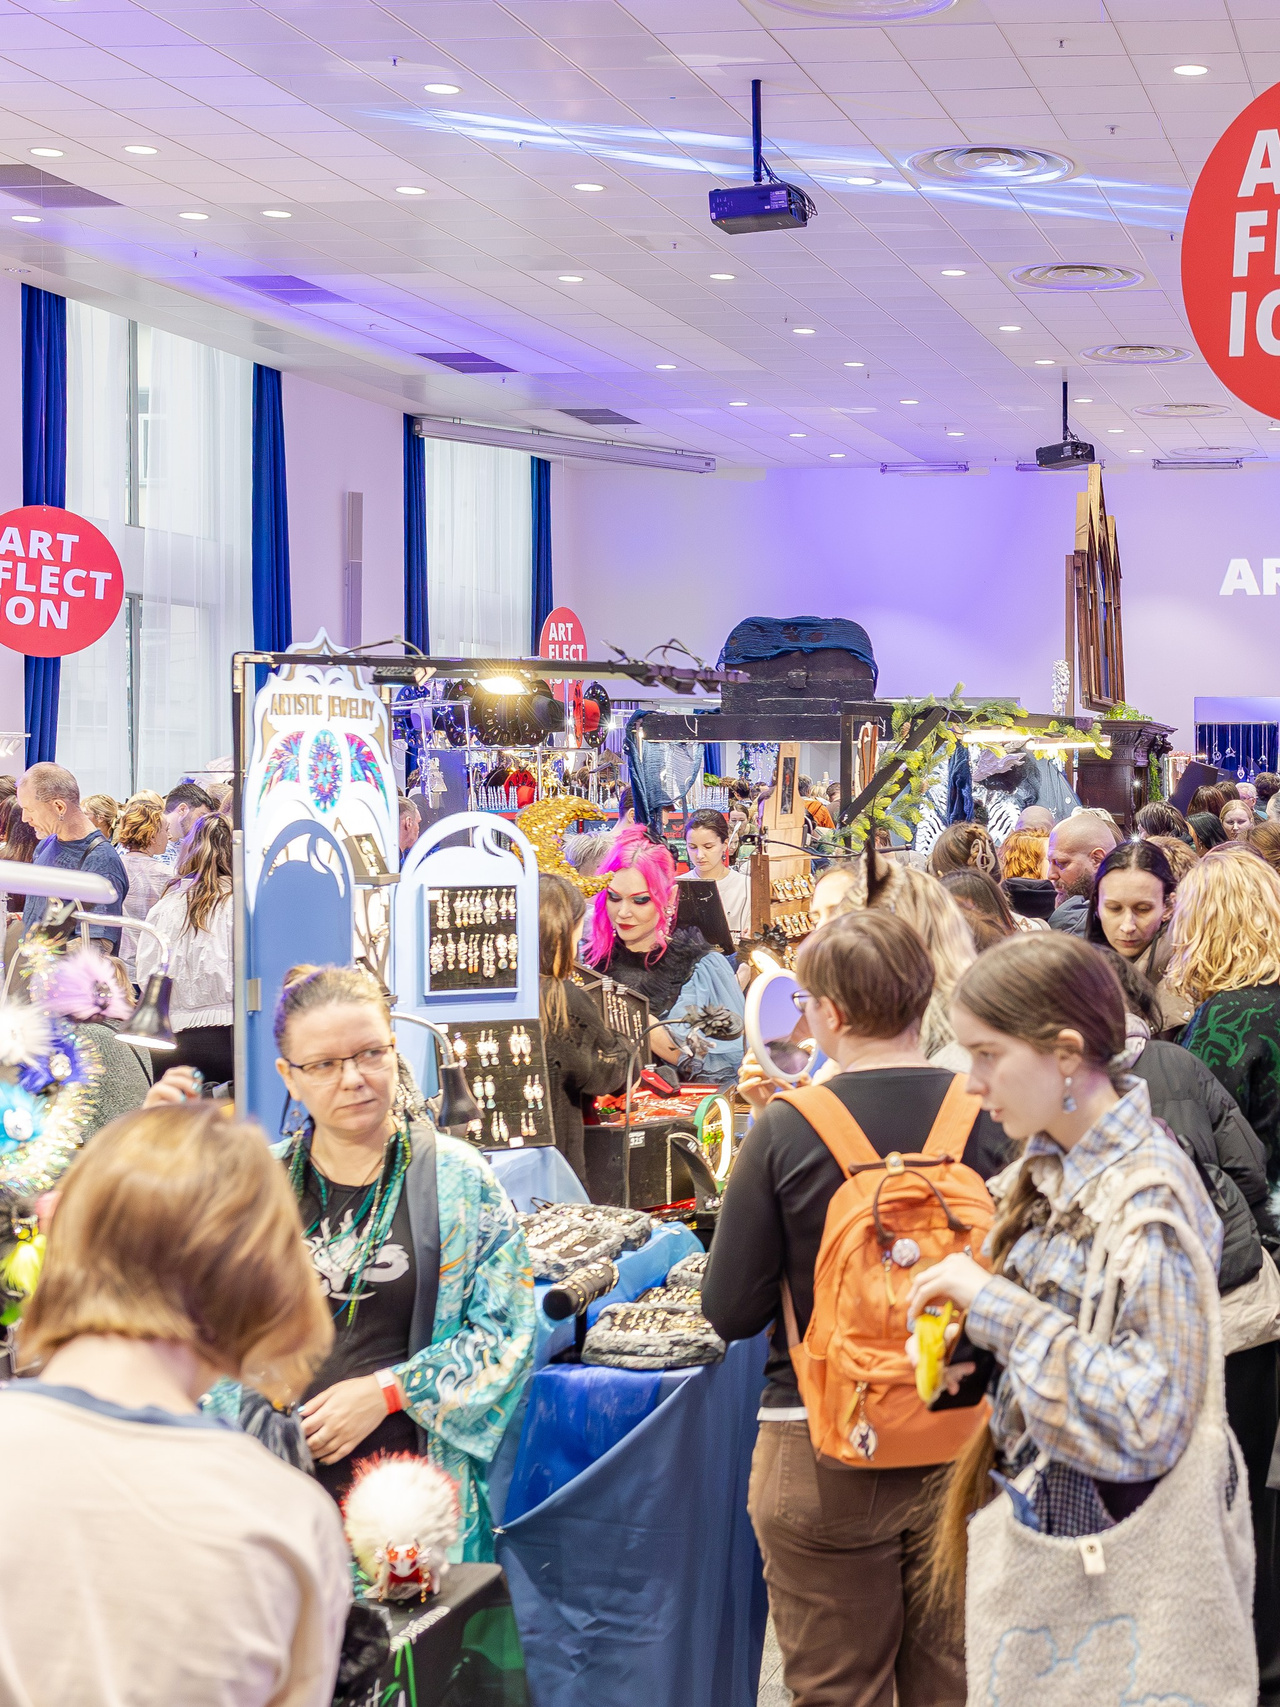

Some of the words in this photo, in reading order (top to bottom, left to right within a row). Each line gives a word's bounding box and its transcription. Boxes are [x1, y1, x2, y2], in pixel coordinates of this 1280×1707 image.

[0, 526, 80, 563] ART
[0, 560, 113, 600] FLECT
[0, 595, 70, 630] ON
[548, 622, 574, 642] ART
[548, 644, 584, 661] FLECT
[270, 693, 323, 716] ARTISTIC
[328, 695, 375, 722] JEWELRY
